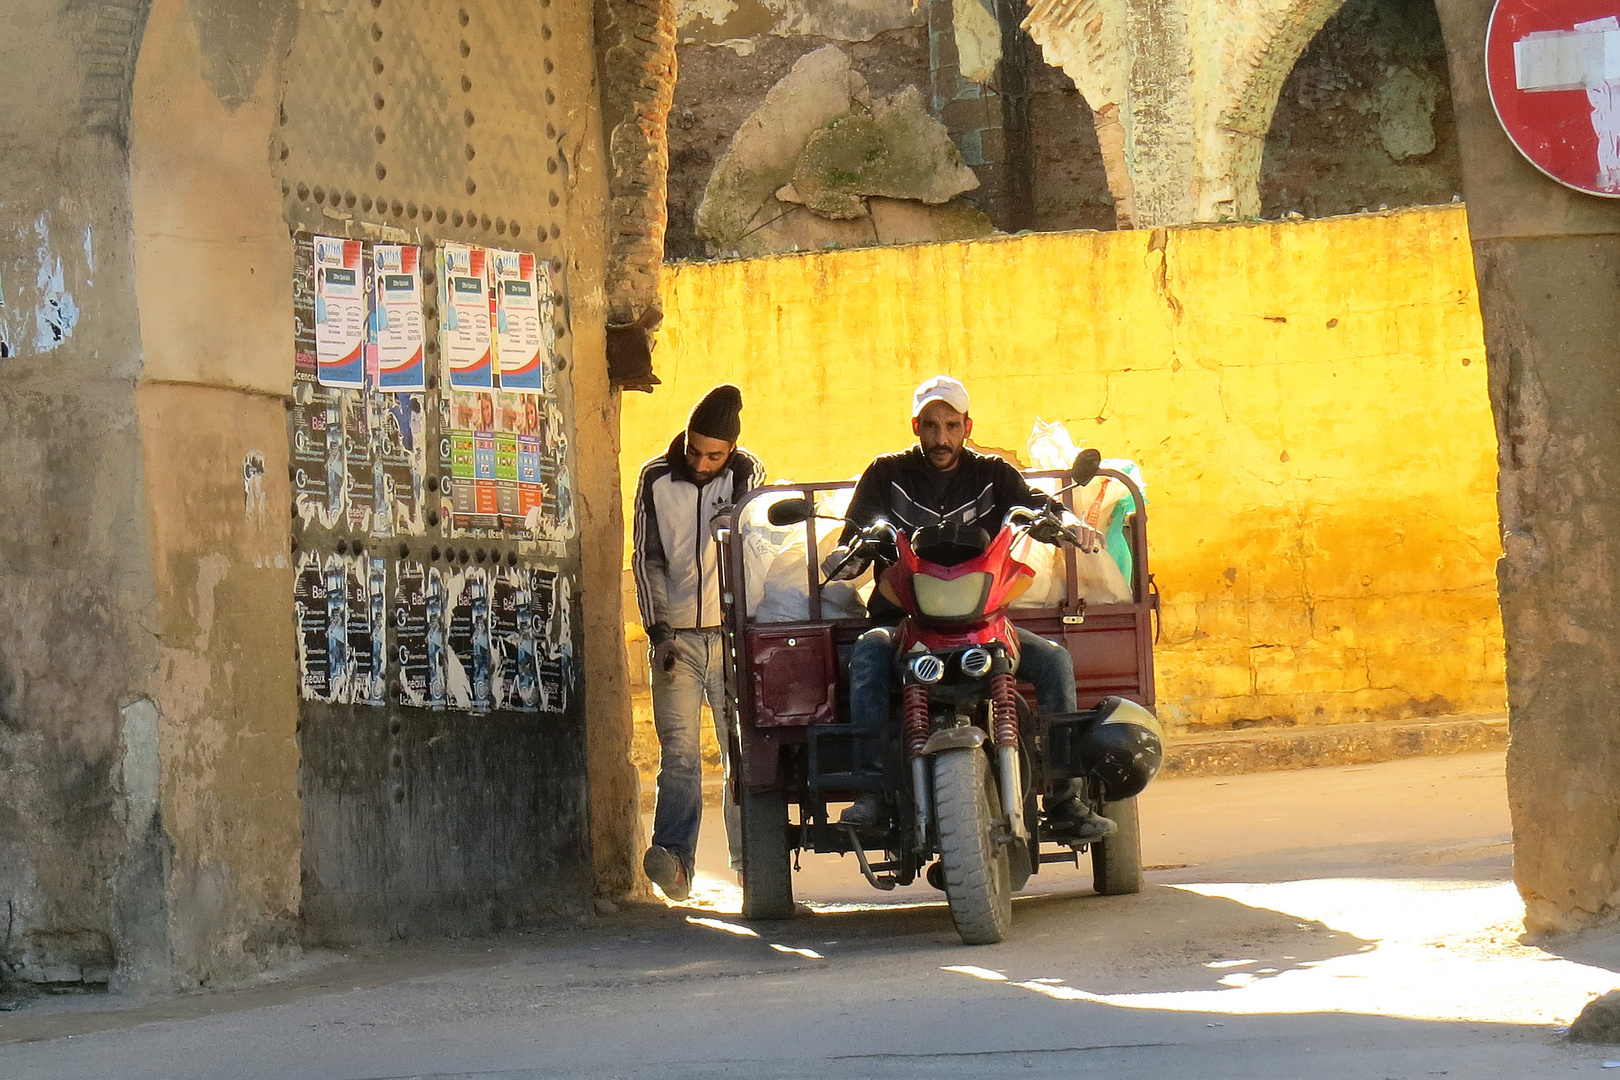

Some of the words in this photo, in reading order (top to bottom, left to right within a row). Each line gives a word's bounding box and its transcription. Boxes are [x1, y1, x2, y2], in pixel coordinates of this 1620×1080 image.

[312, 416, 327, 431] Bac
[312, 585, 327, 599] Bac
[412, 592, 426, 606] Bac
